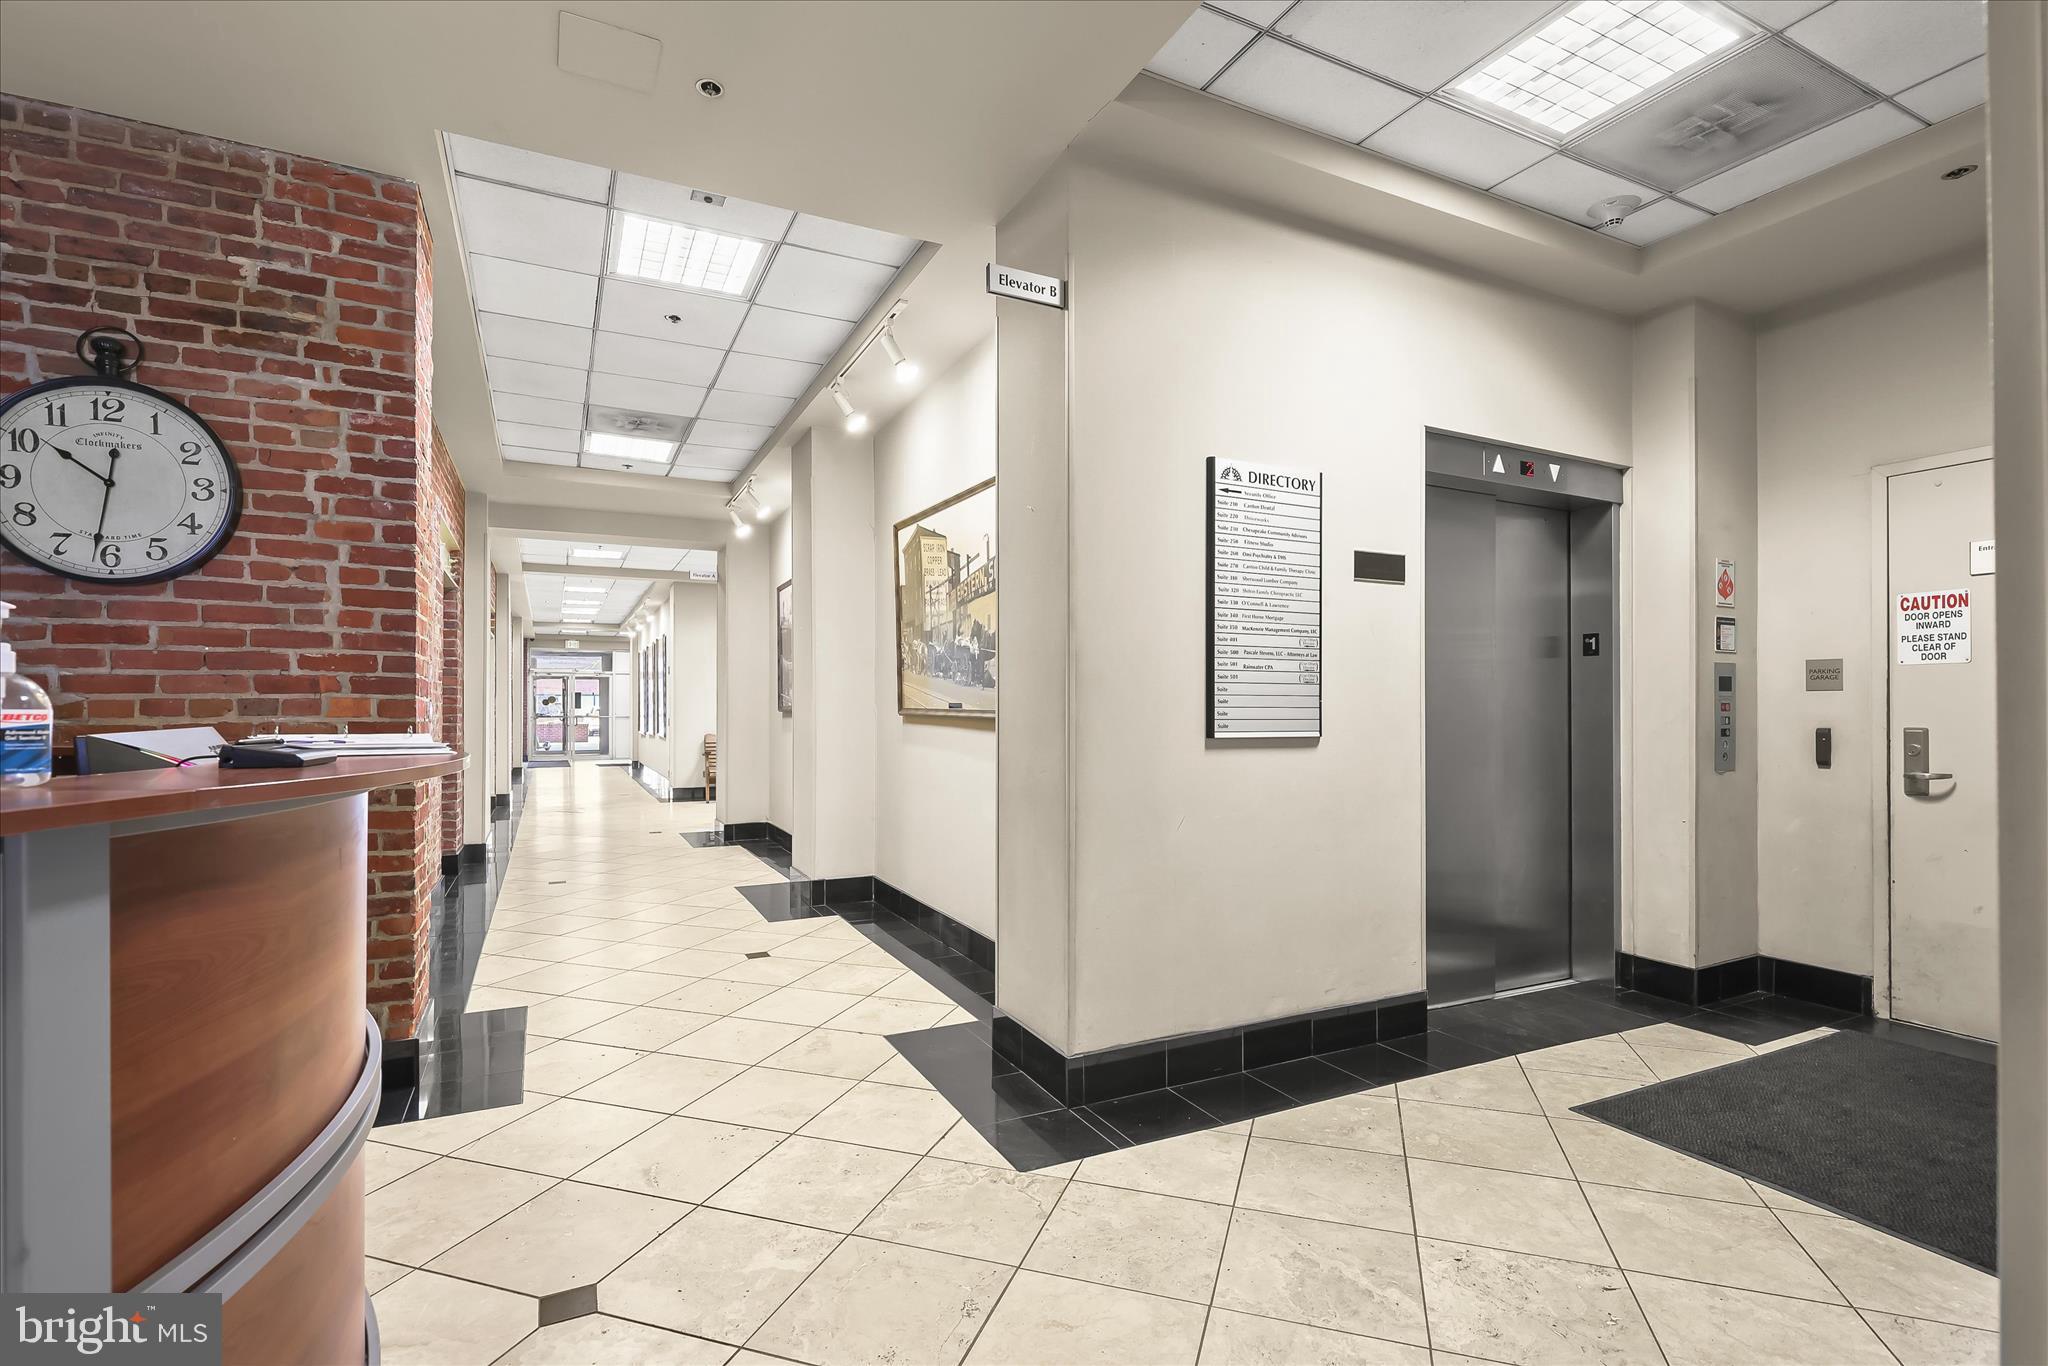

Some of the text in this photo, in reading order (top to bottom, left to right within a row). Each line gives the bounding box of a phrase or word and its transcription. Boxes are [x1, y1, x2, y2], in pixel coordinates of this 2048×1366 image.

[999, 274, 1057, 297] Elevator B
[44, 403, 69, 427] 11
[90, 398, 125, 423] 12
[150, 412, 163, 435] 1
[8, 428, 40, 453] 10
[75, 437, 142, 450] Clockmakers
[180, 441, 202, 466] 2
[0, 464, 21, 489] 9
[1248, 471, 1316, 492] DIRECTORY
[191, 478, 215, 501] 3
[12, 502, 37, 526] 8
[177, 512, 203, 536] 4
[50, 532, 72, 556] 7
[80, 530, 142, 540] STAARD TIME
[100, 544, 122, 568] 6
[146, 538, 168, 561] 5
[1217, 561, 1229, 569] Suite
[1900, 593, 1969, 612] CAUTION
[1904, 611, 1963, 622] DOOR OPENS
[1916, 620, 1951, 630] INWARD
[1901, 632, 1967, 643] PLEASE STAND
[1912, 642, 1957, 652] CLEAR OF
[1921, 652, 1947, 661] DOOR
